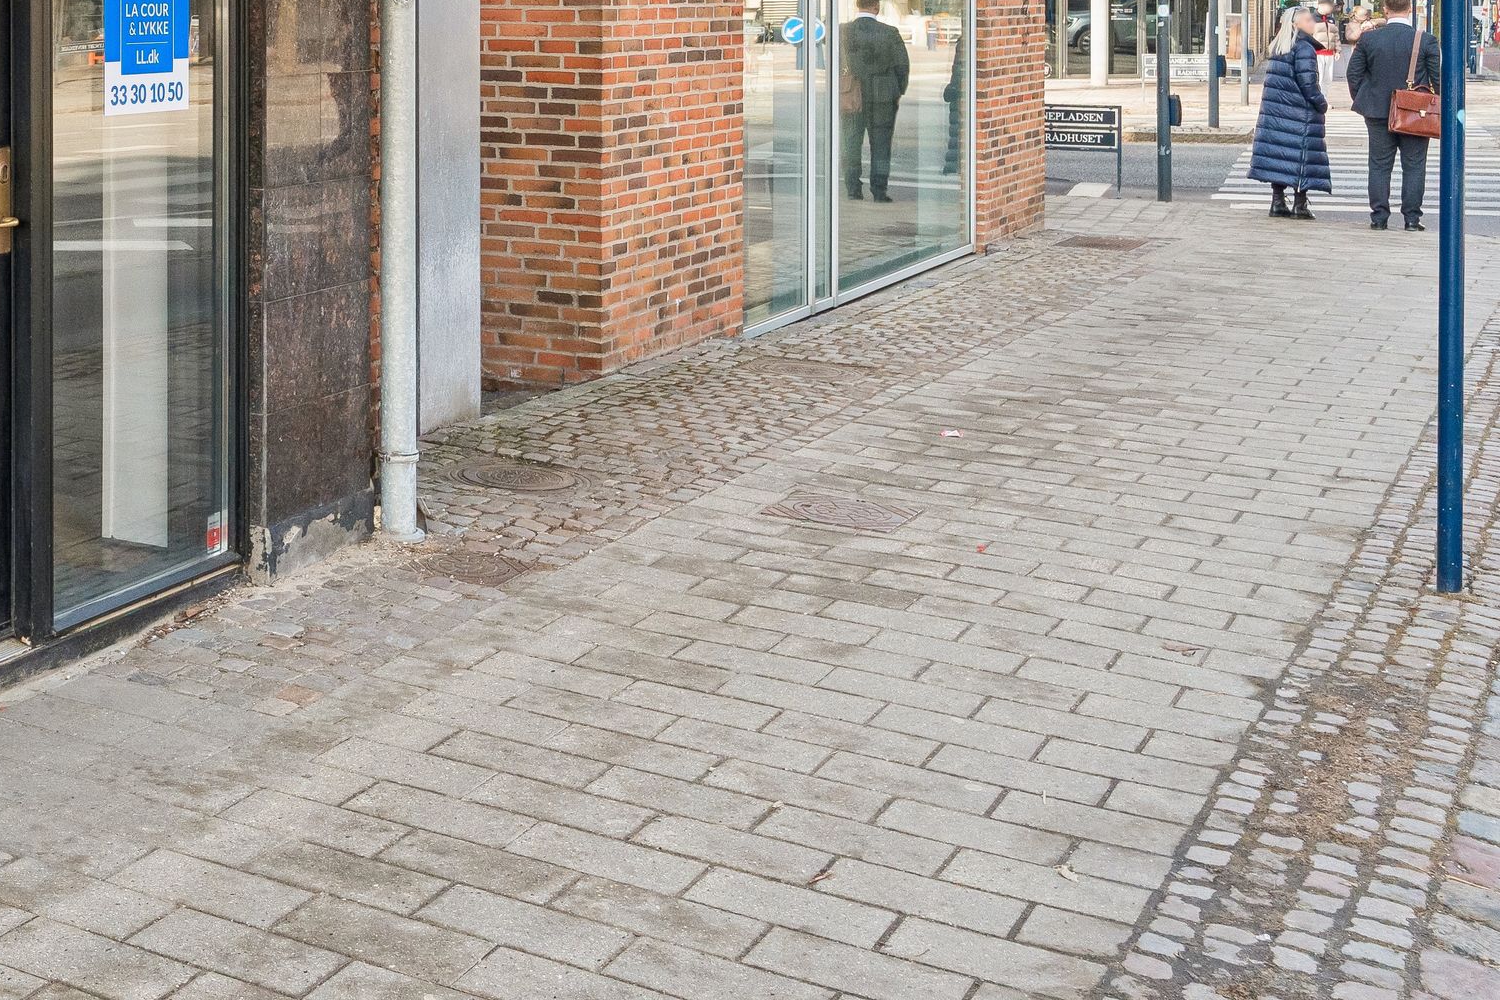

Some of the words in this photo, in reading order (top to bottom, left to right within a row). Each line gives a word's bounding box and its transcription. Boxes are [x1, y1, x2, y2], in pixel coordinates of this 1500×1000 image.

[125, 3, 139, 17] LA
[141, 3, 169, 17] COUR
[129, 21, 137, 36] &
[138, 21, 169, 36] LYKKE
[136, 49, 160, 65] LL.dk
[111, 84, 127, 106] 33
[130, 84, 147, 105] 30
[150, 82, 166, 103] 10
[168, 81, 184, 102] 50
[1045, 132, 1104, 144] RÅDHUSET
